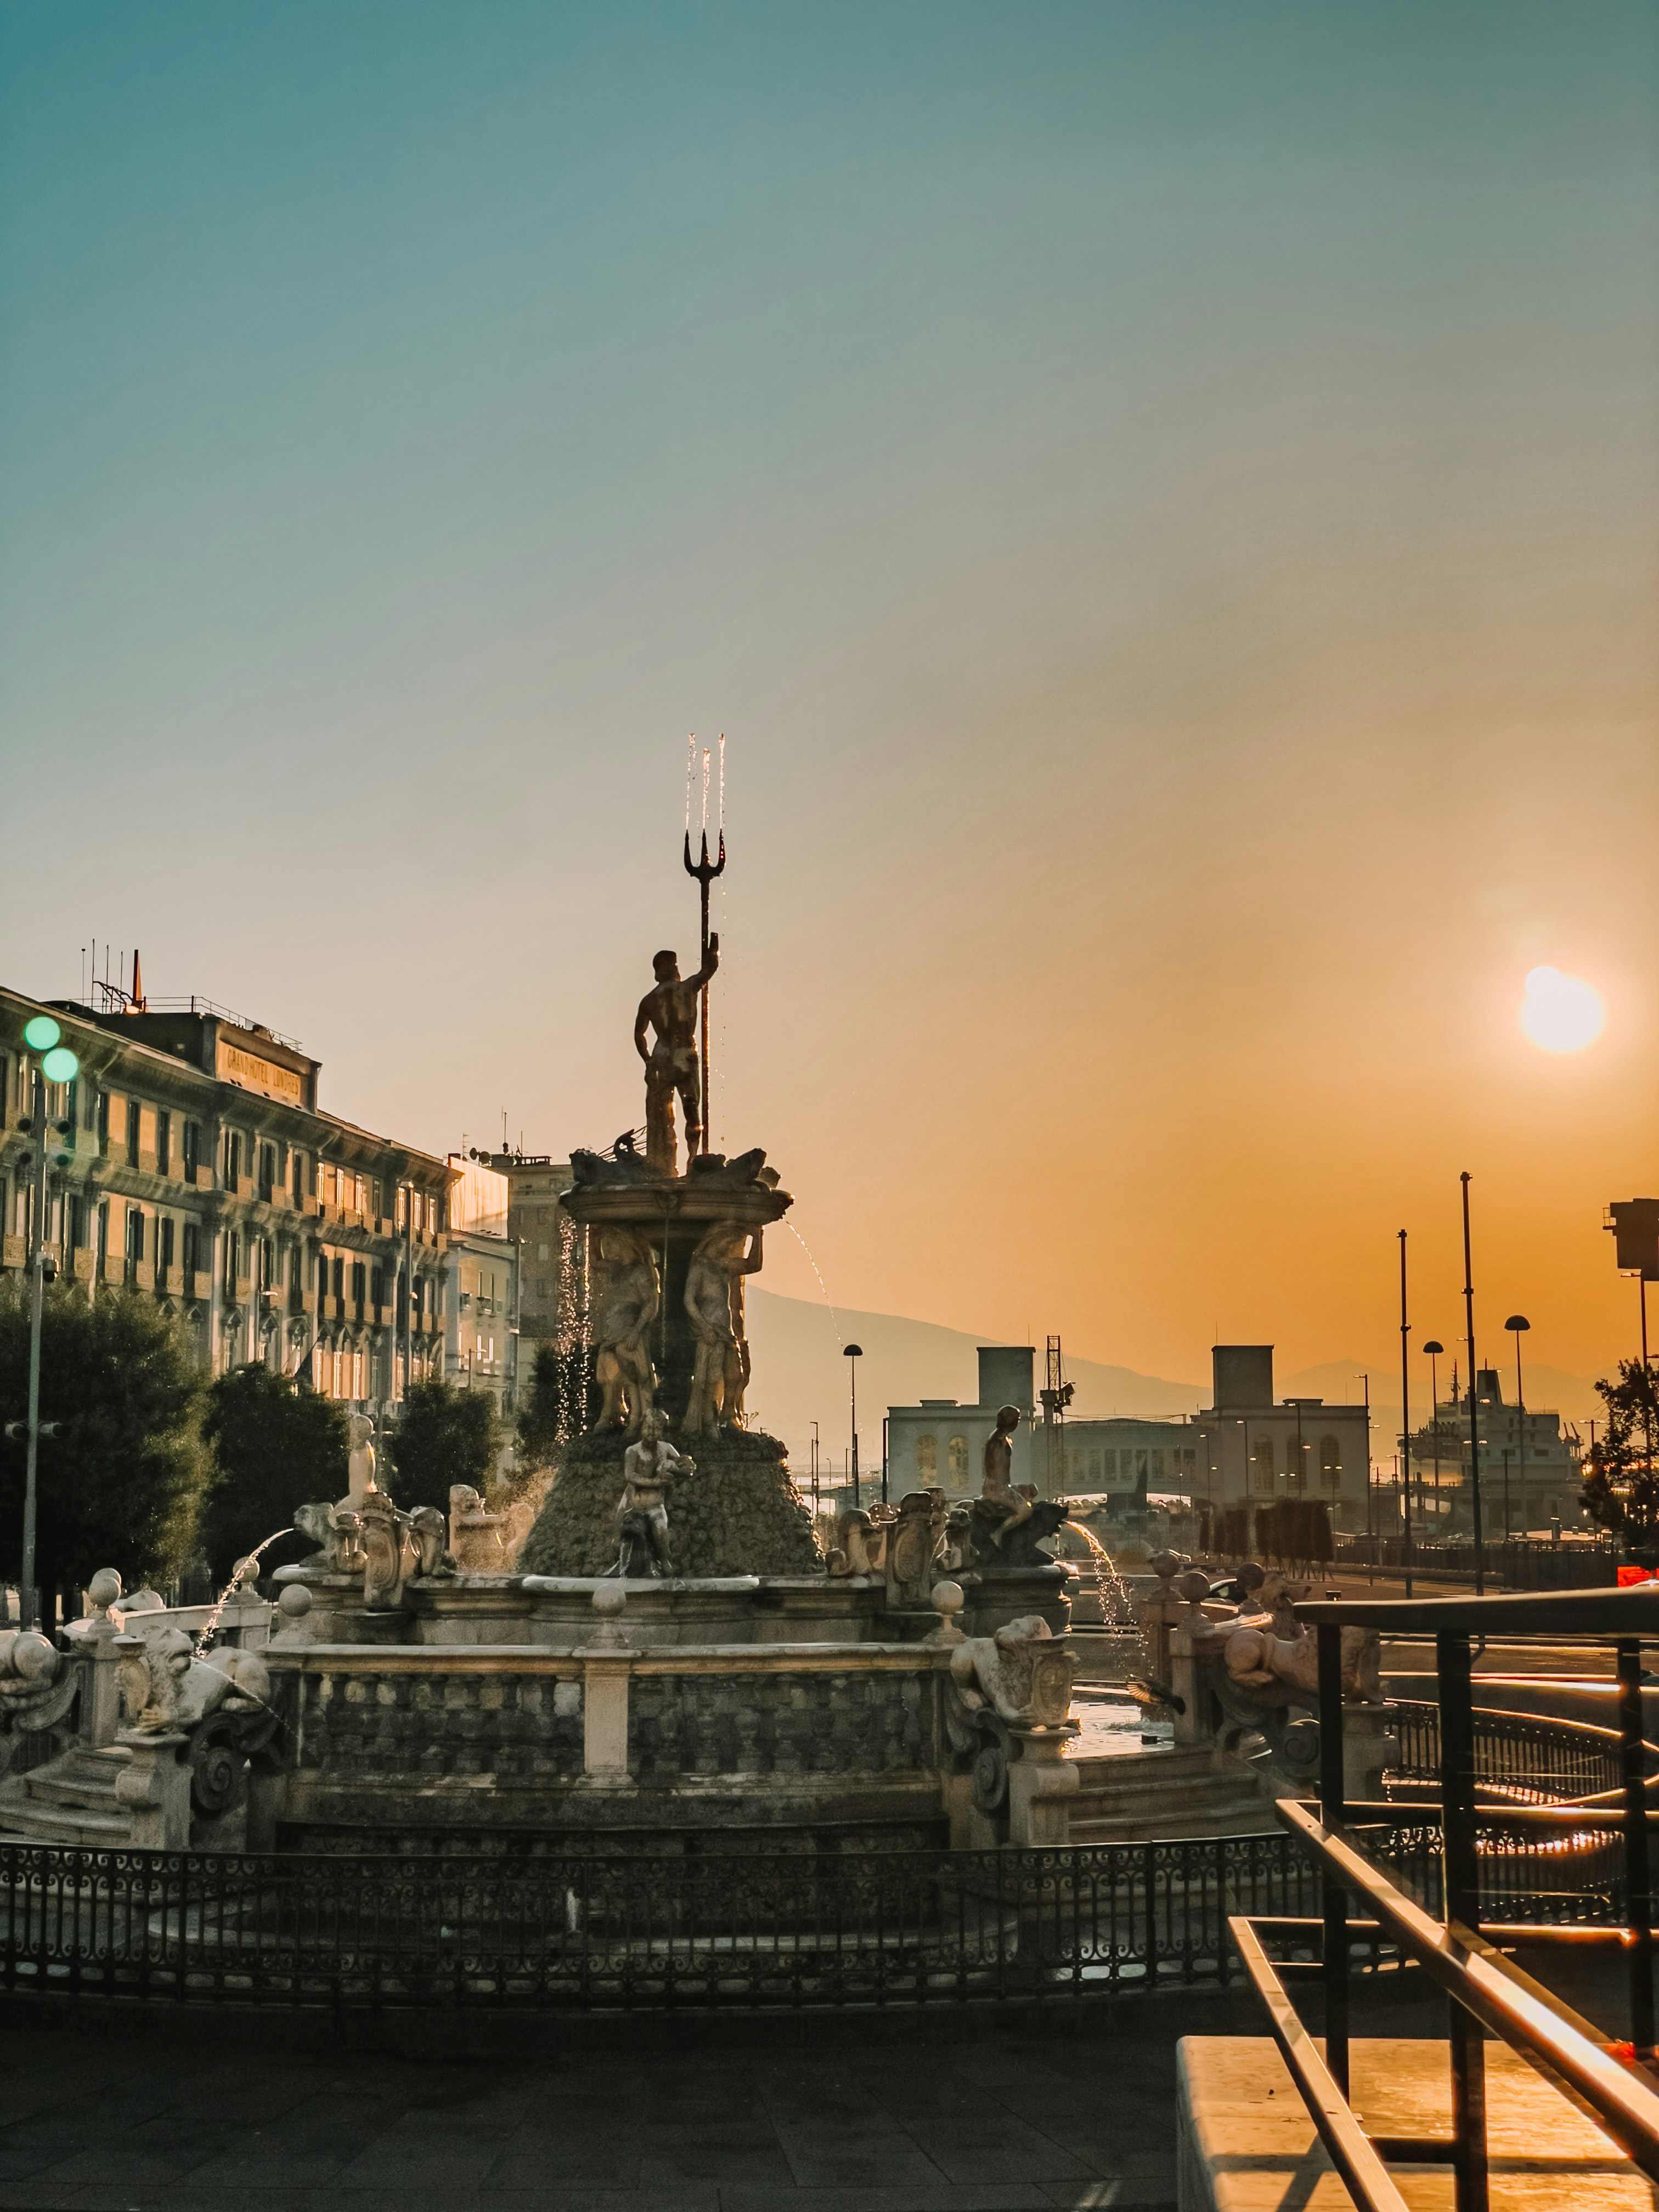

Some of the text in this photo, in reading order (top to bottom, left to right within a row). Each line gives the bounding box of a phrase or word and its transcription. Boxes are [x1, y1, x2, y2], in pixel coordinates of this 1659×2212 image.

[228, 1048, 299, 1095] GRAND HOTEL LONDRES
